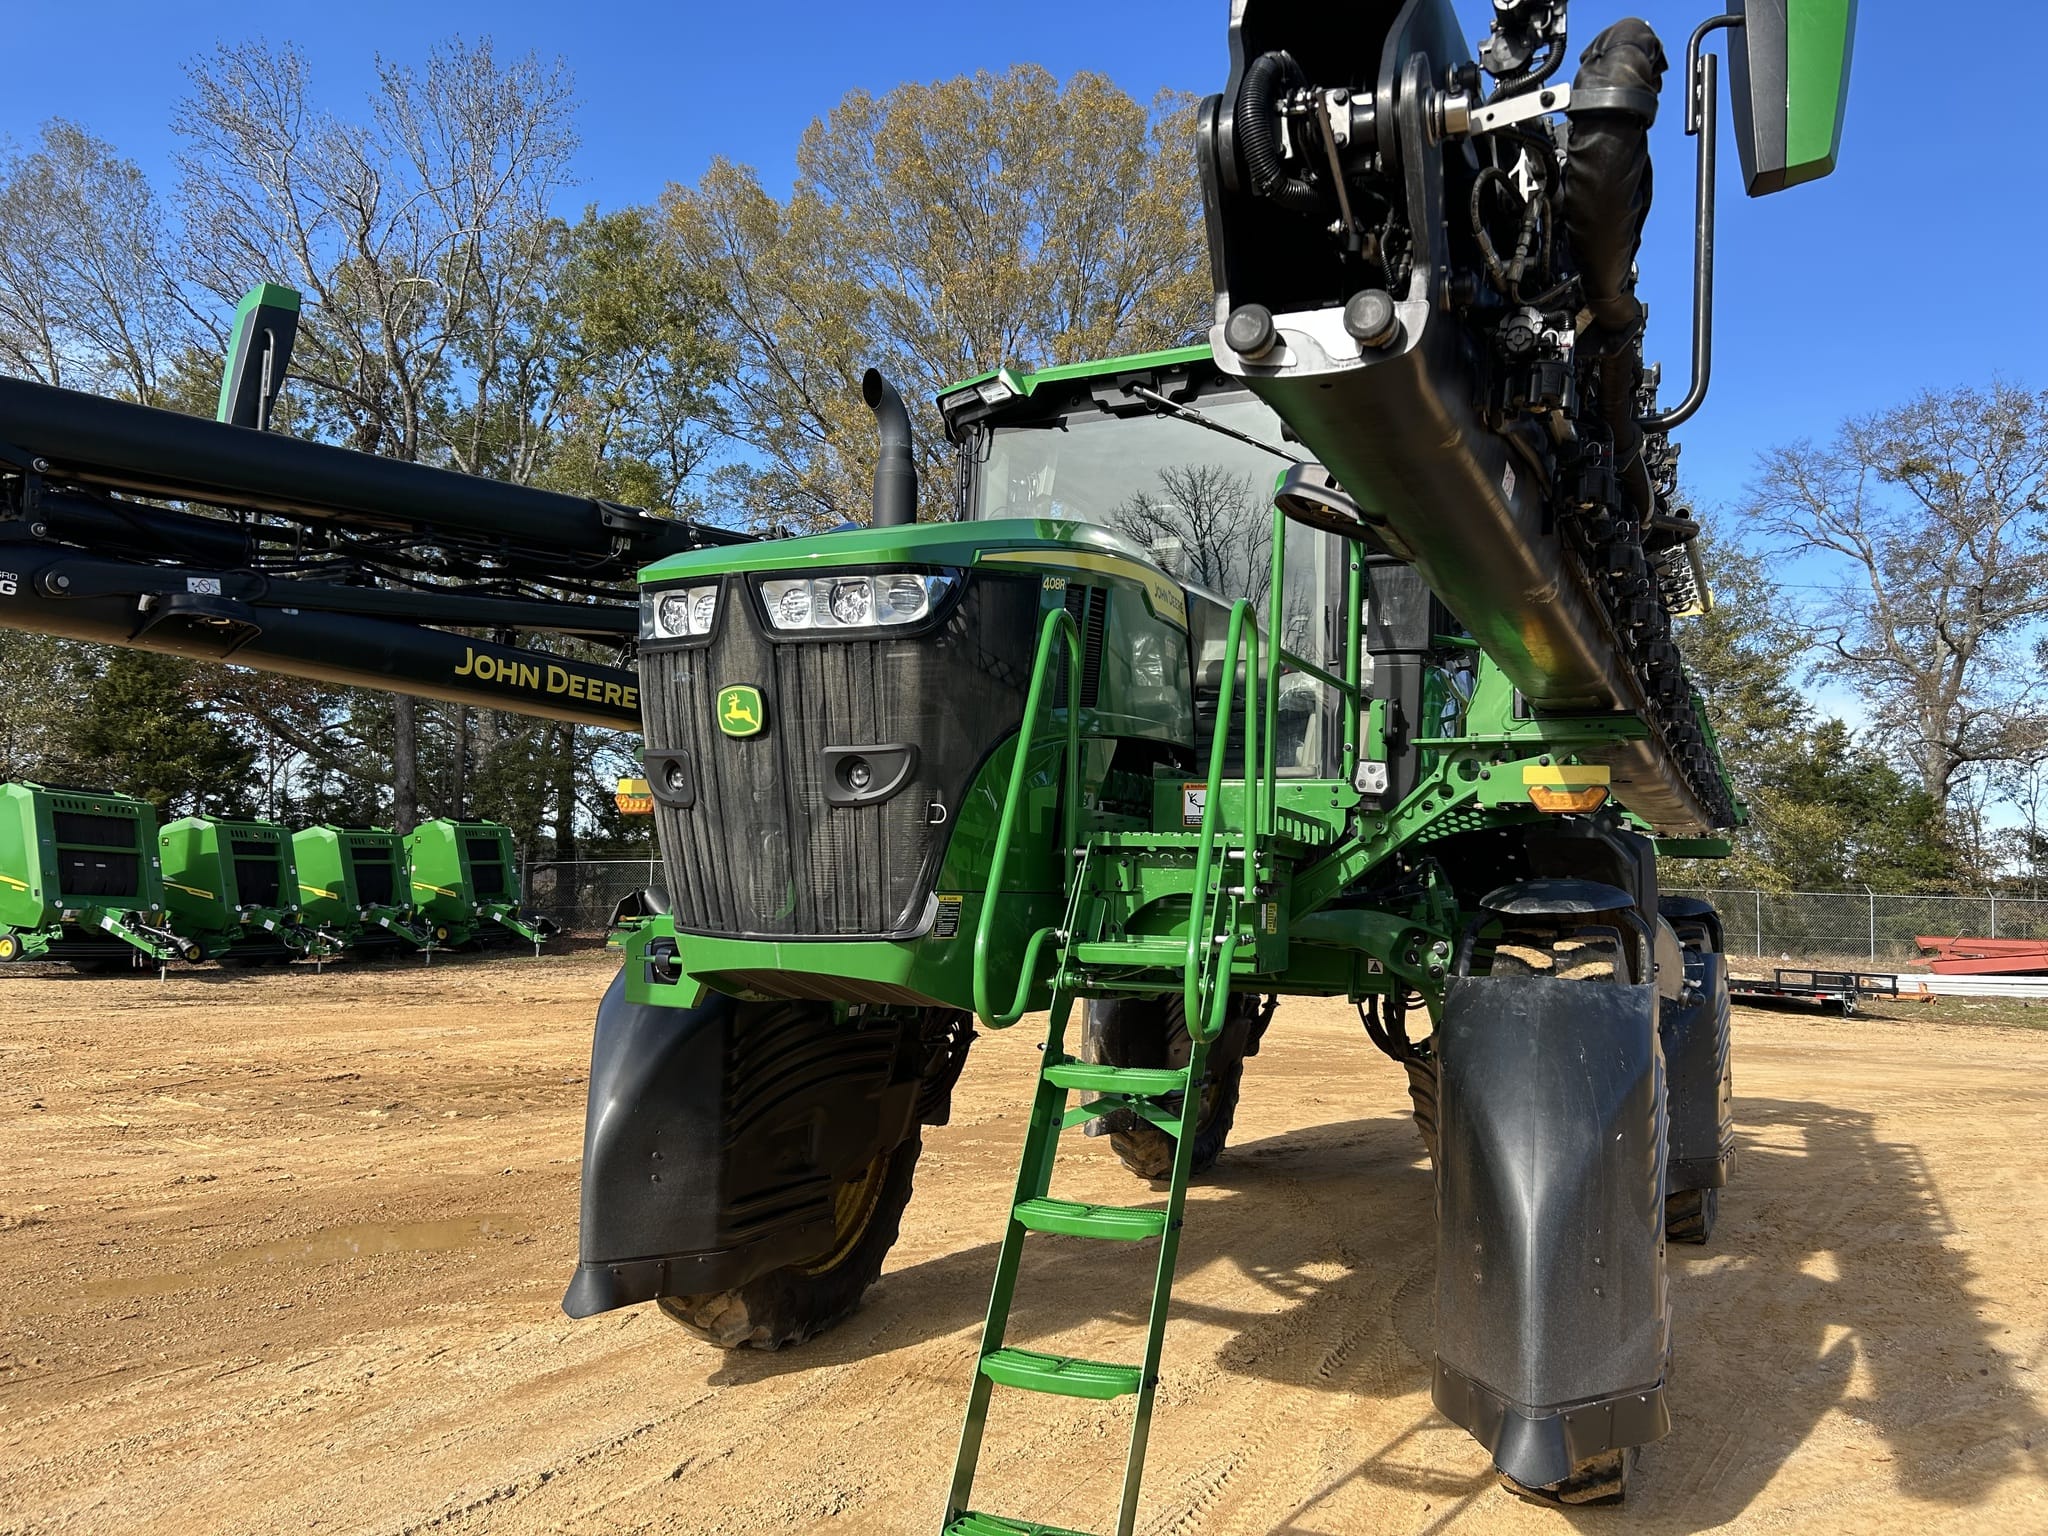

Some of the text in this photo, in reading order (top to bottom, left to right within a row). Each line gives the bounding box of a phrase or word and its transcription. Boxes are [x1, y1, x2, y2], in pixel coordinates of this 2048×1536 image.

[0, 571, 18, 581] RO
[1043, 576, 1066, 591] 408R
[454, 647, 639, 709] JOHN DEERE
